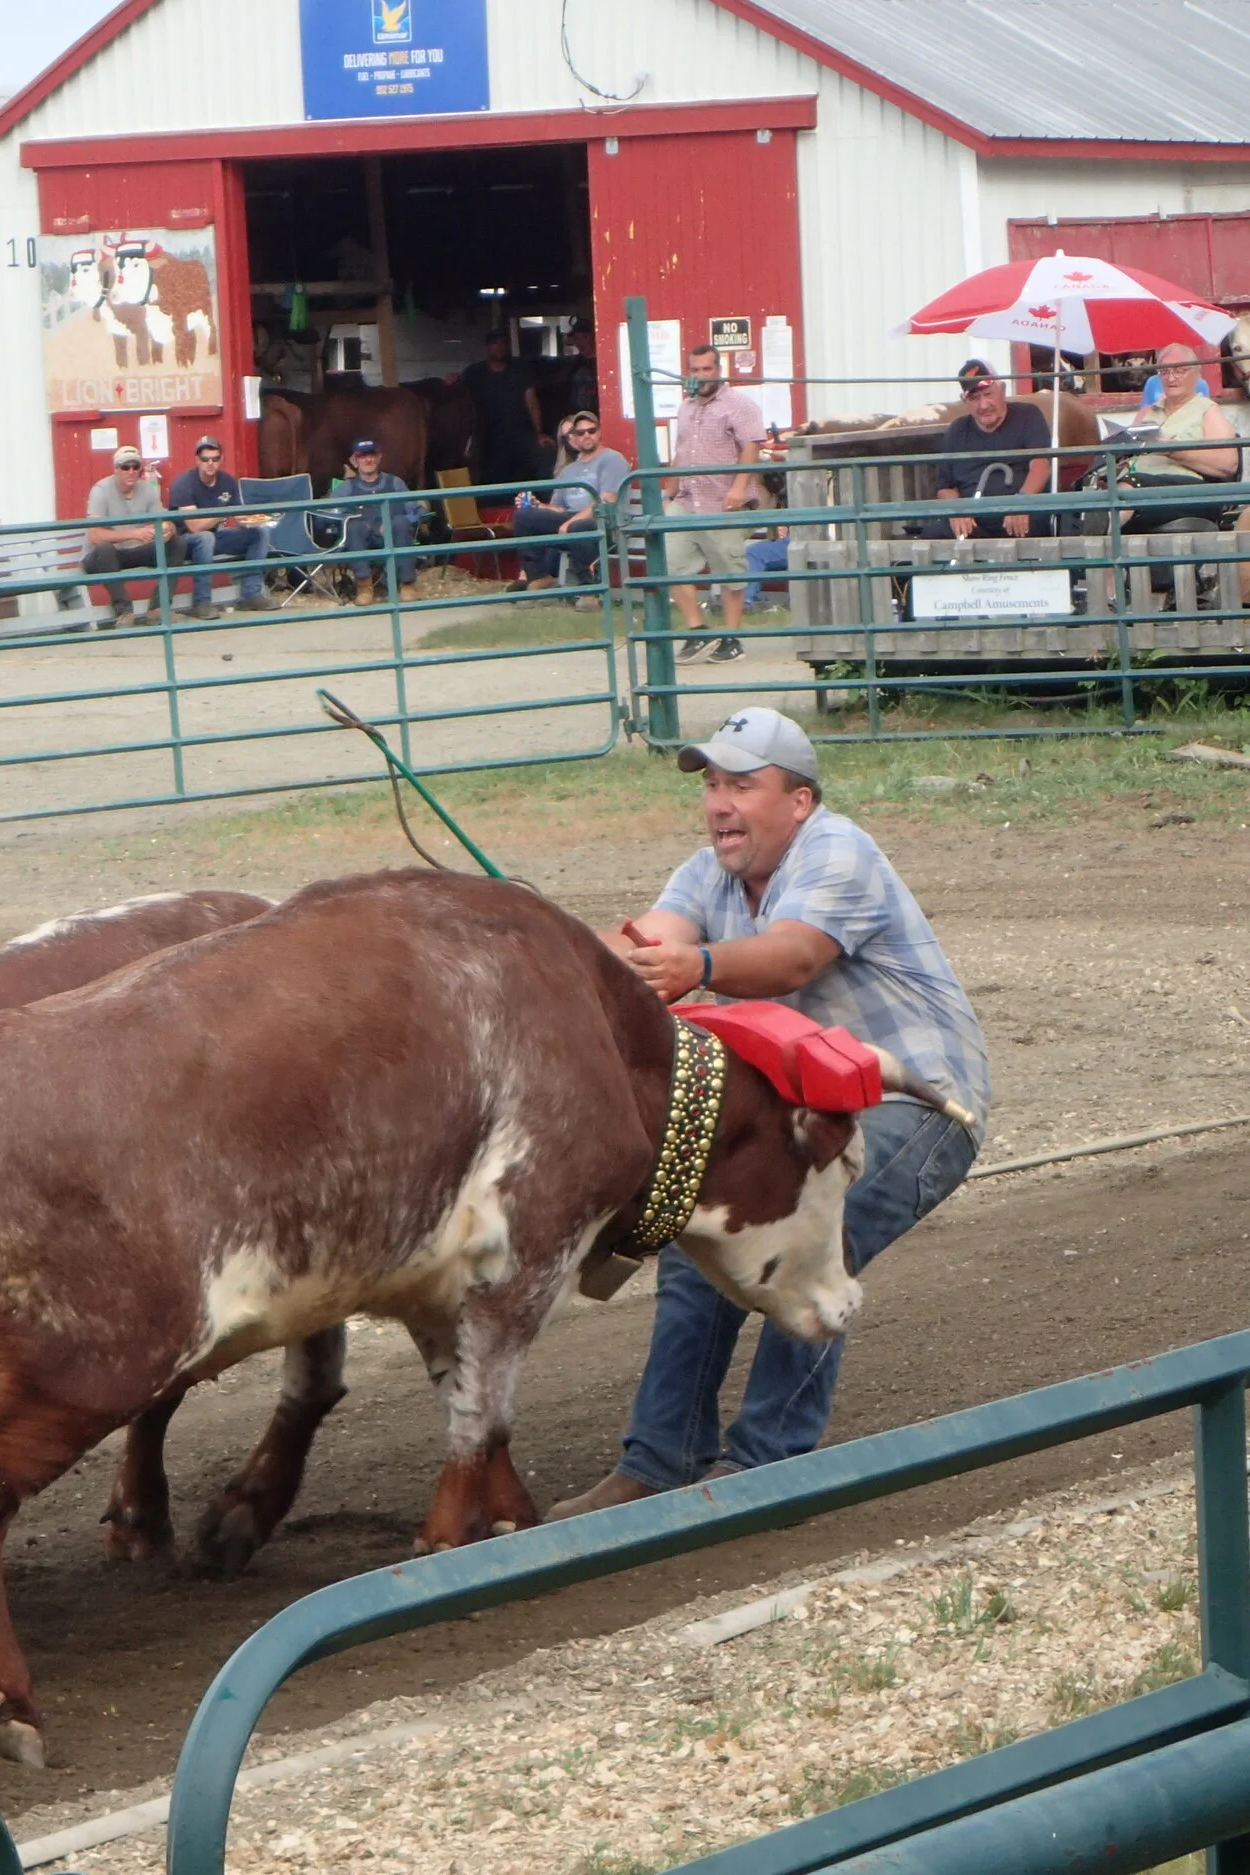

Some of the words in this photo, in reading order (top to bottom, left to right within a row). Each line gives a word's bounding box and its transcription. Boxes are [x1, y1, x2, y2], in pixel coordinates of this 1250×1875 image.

[344, 52, 387, 68] DELIVERING
[411, 50, 426, 64] FOR
[427, 48, 444, 63] YOU
[6, 236, 37, 268] 10
[722, 322, 738, 334] NO
[713, 332, 748, 345] SMOKING
[62, 379, 114, 406] LION
[125, 376, 204, 404] BRIGHT
[934, 598, 981, 611] Campbell
[985, 598, 1049, 609] Amusements
